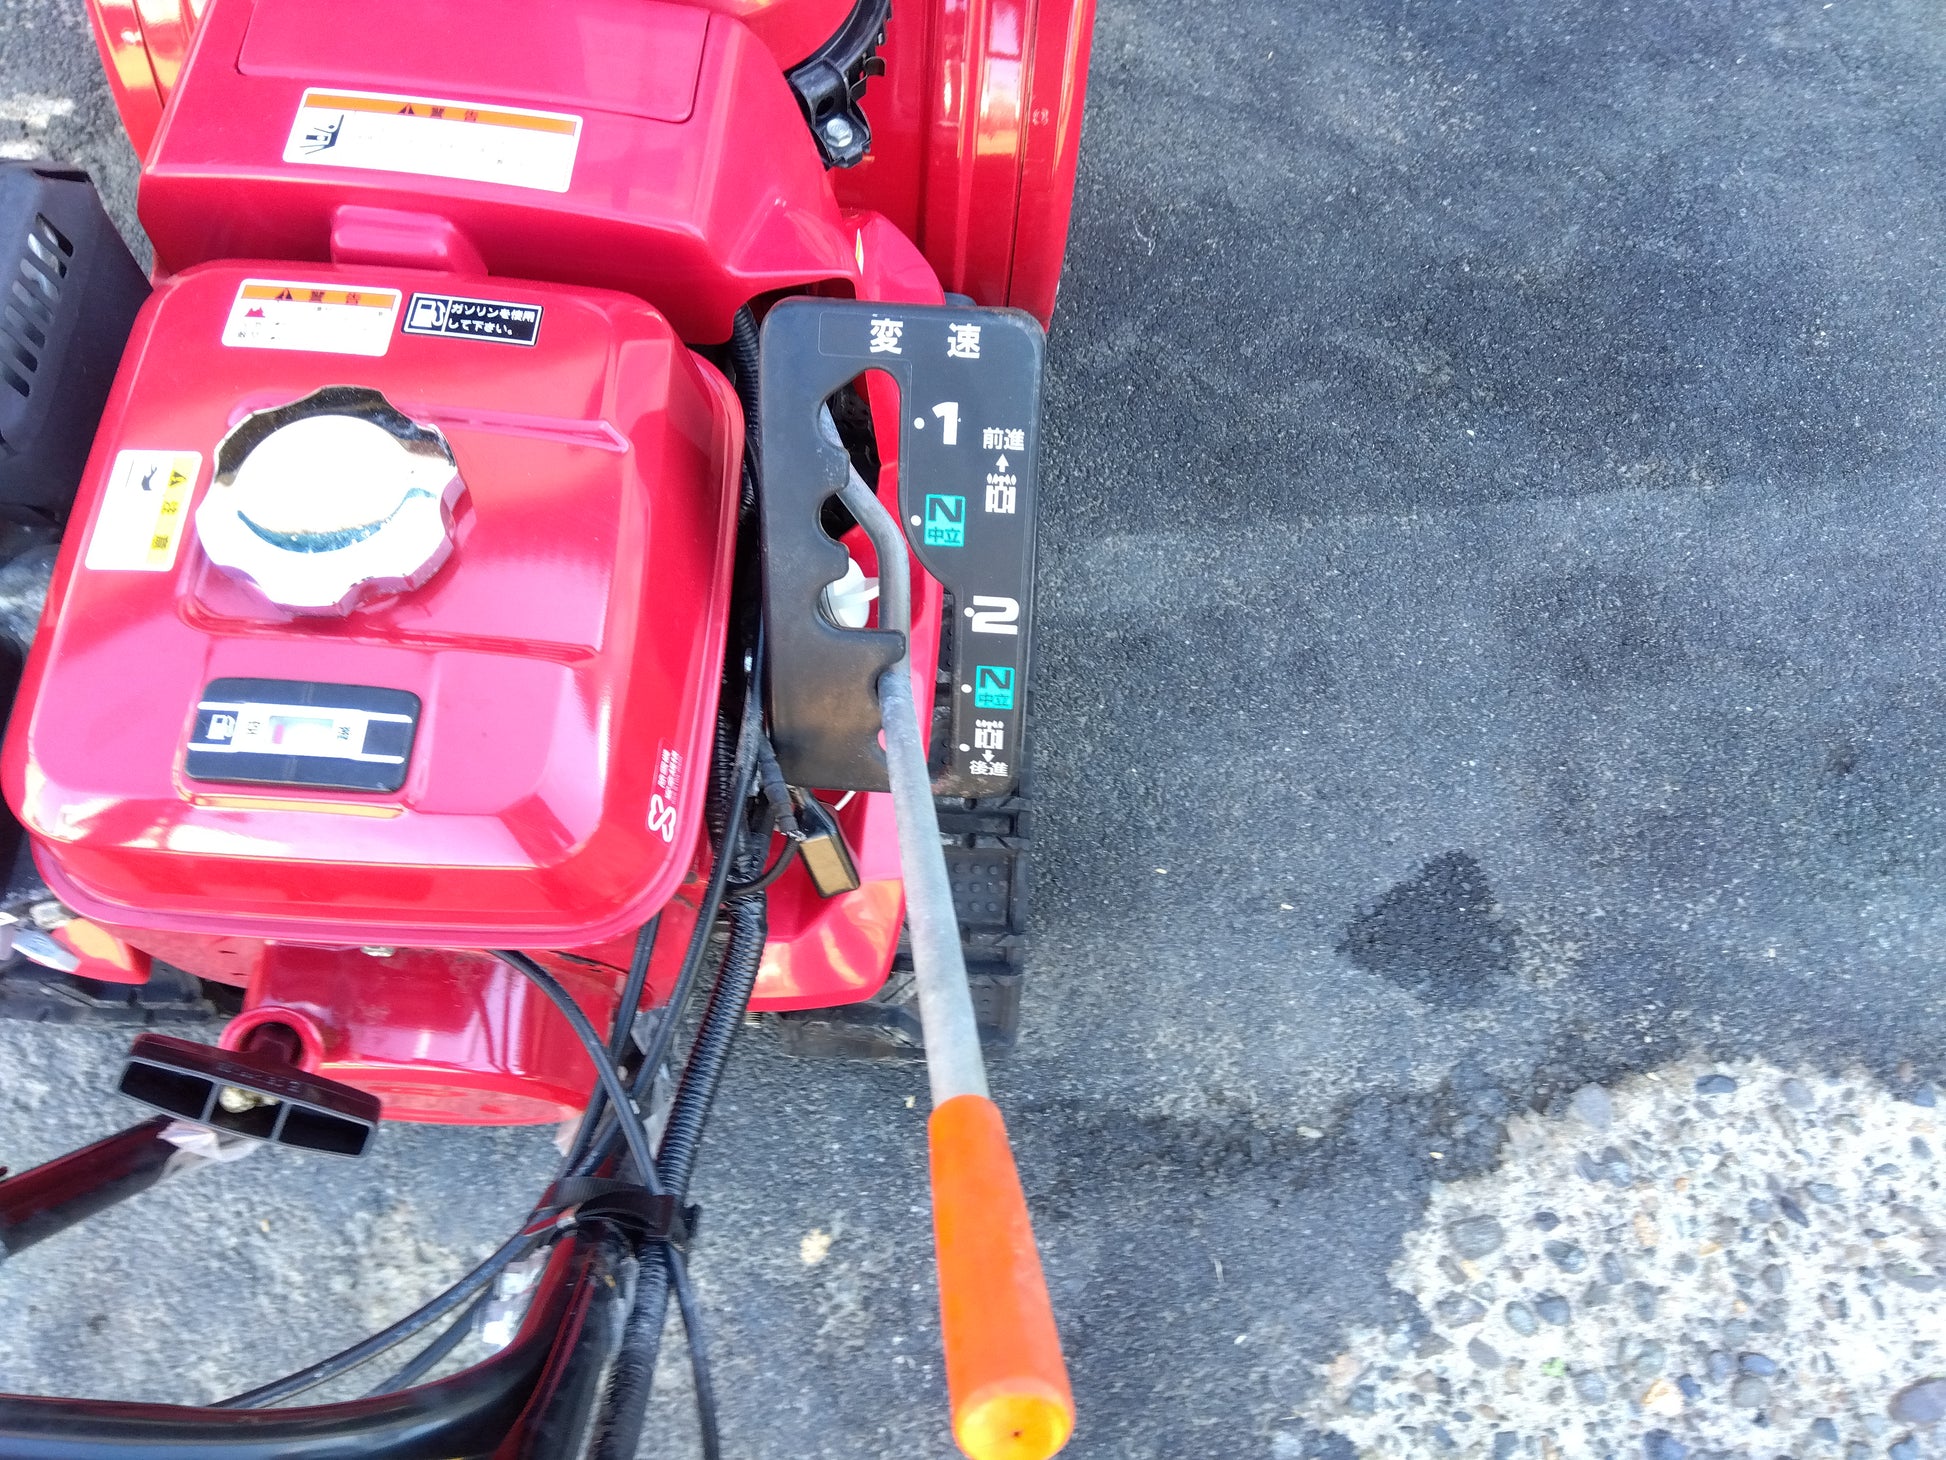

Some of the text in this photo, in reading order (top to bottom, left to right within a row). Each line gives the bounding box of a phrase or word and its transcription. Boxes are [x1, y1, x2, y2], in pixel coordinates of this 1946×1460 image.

[450, 302, 536, 323] ガソリンを使用
[869, 313, 982, 359] 変速
[931, 401, 960, 446] 1
[983, 427, 1025, 451] 前進
[927, 497, 963, 523] N
[927, 526, 961, 543] 中立
[971, 595, 1020, 635] 2
[979, 668, 1011, 690] N
[978, 692, 1010, 707] 中立
[969, 760, 1009, 777] 後進
